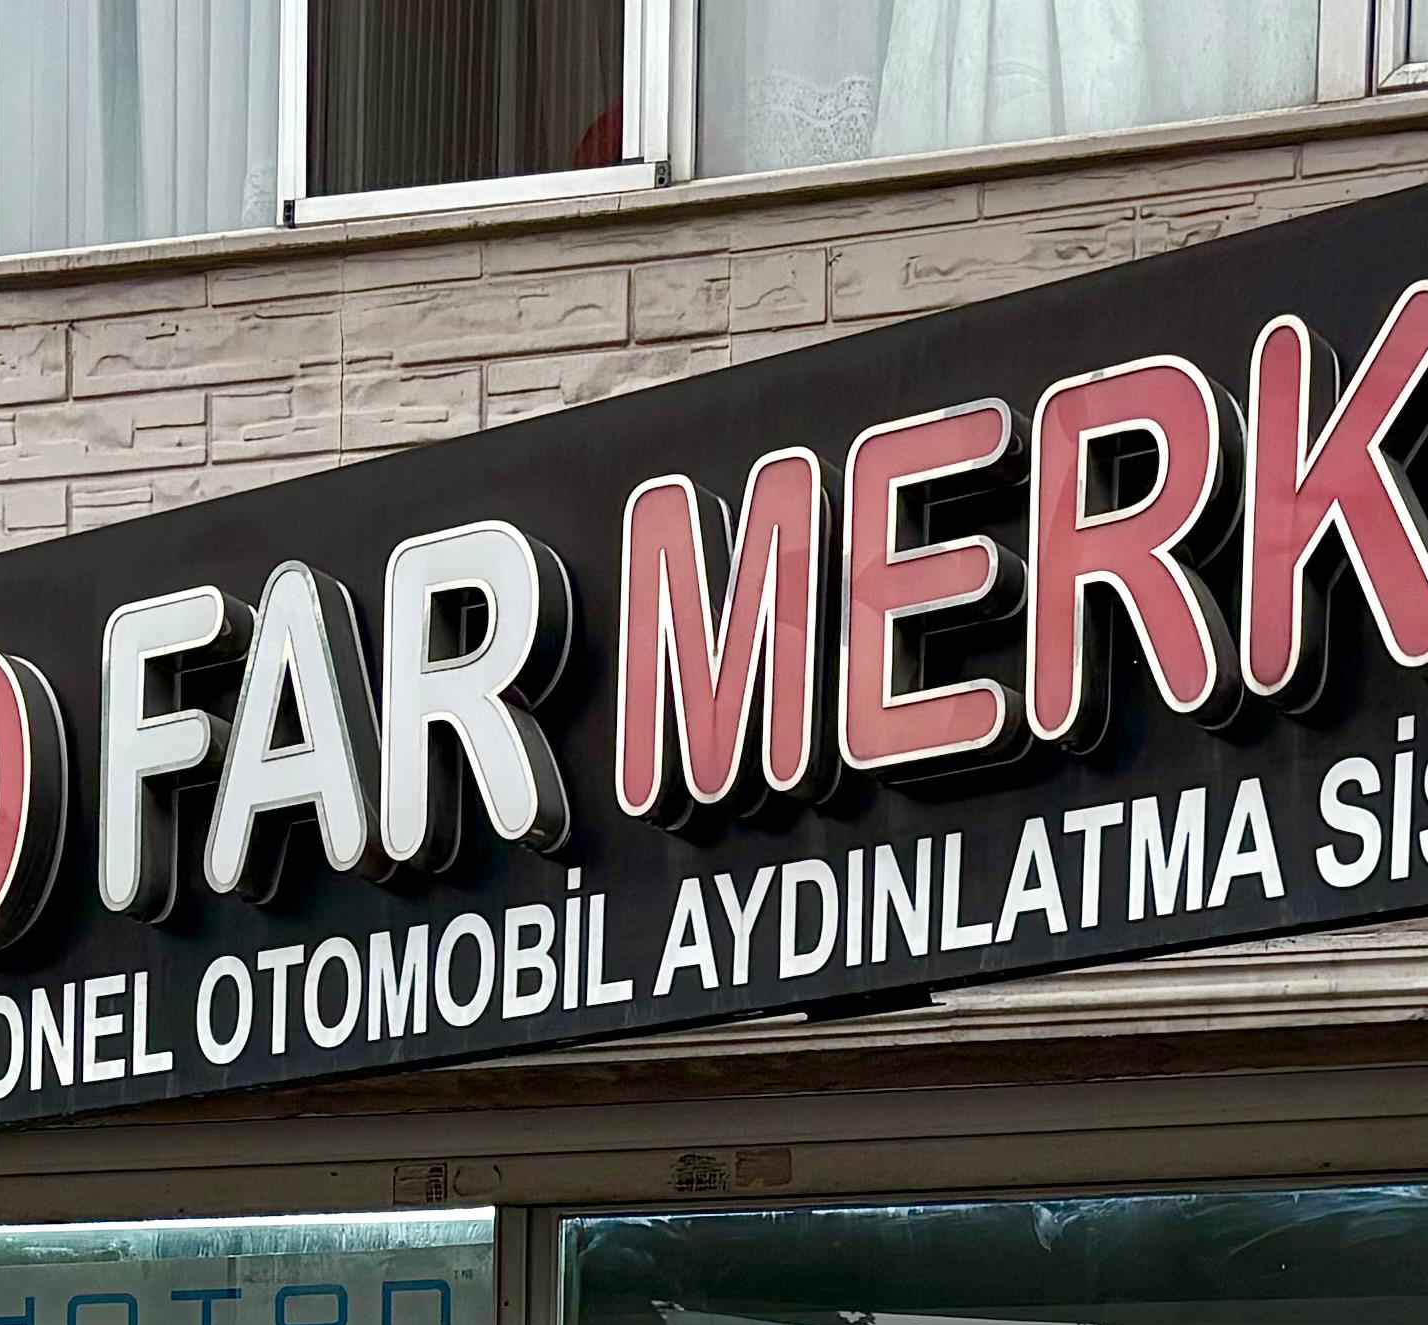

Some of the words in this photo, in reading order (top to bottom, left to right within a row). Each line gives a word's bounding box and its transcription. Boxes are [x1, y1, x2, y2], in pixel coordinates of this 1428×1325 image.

[98, 519, 542, 913] FAR
[195, 867, 634, 1066] OTOMOBİL
[652, 777, 1288, 999] AYDINLATMA
